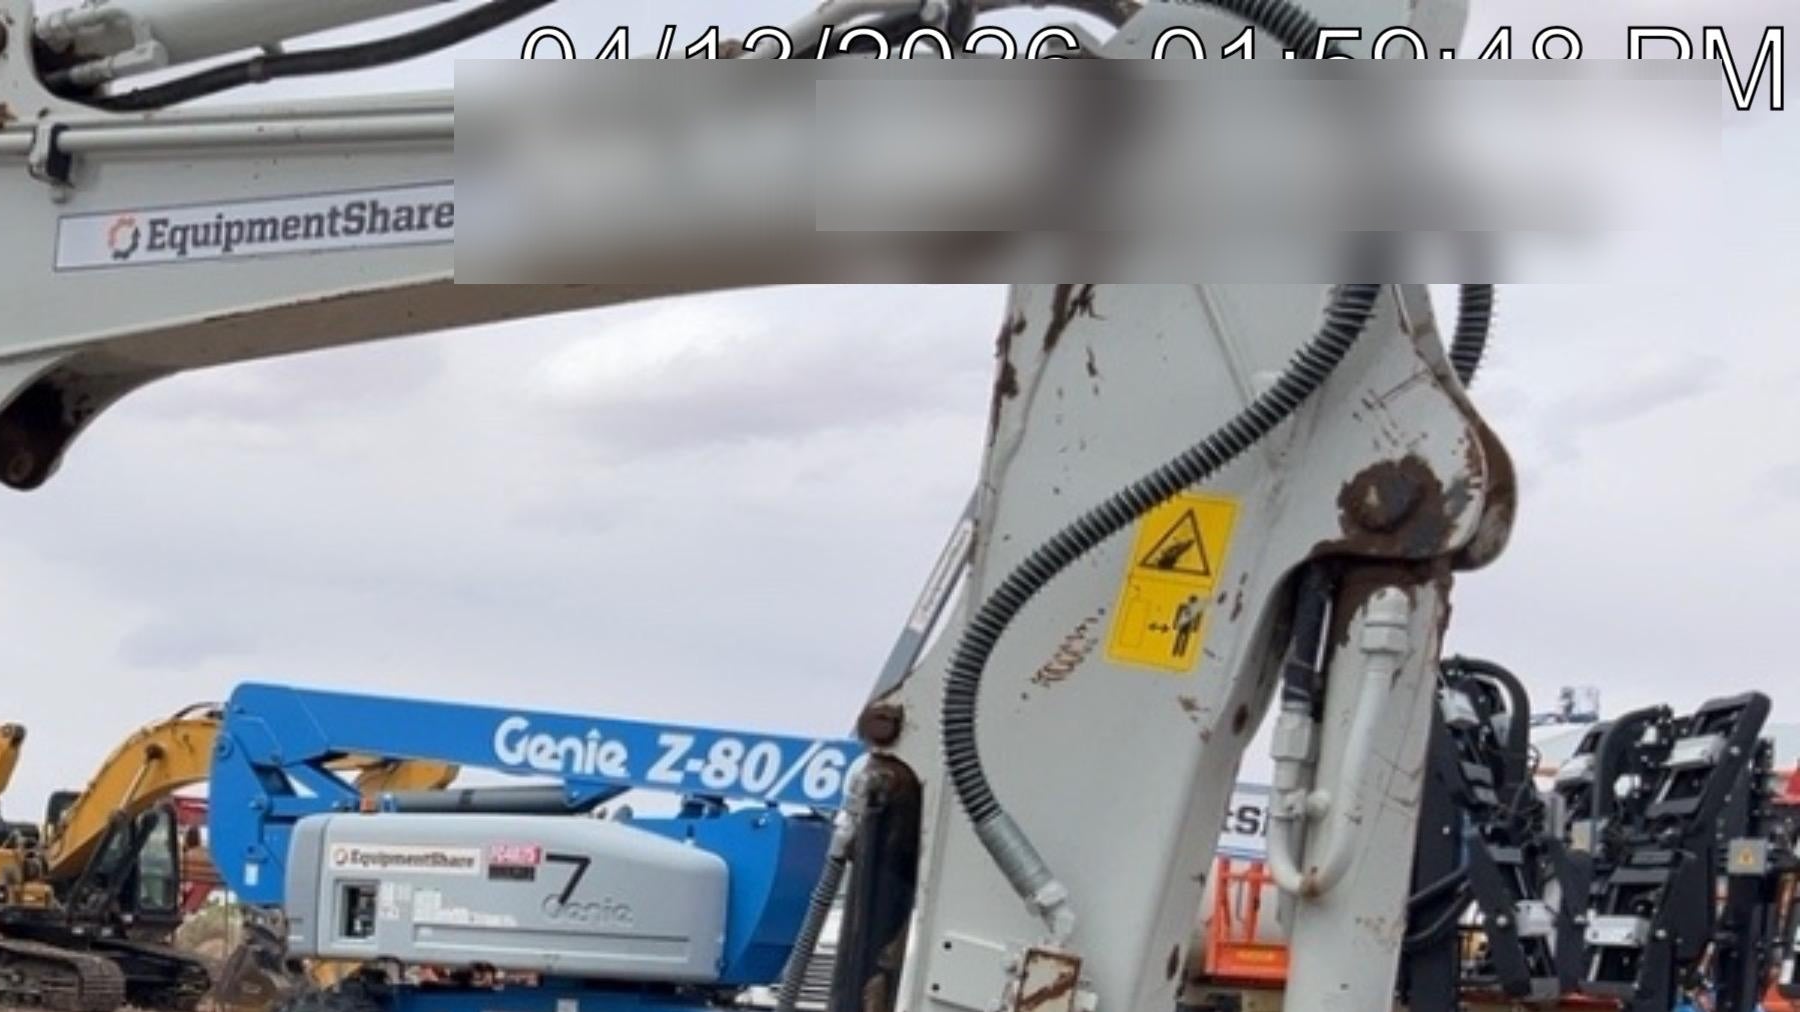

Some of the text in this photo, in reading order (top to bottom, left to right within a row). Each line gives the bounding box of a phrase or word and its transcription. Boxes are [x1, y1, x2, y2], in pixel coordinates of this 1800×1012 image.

[145, 200, 455, 256] EquipmentShare
[494, 716, 630, 777] Genie
[546, 853, 591, 905] 7
